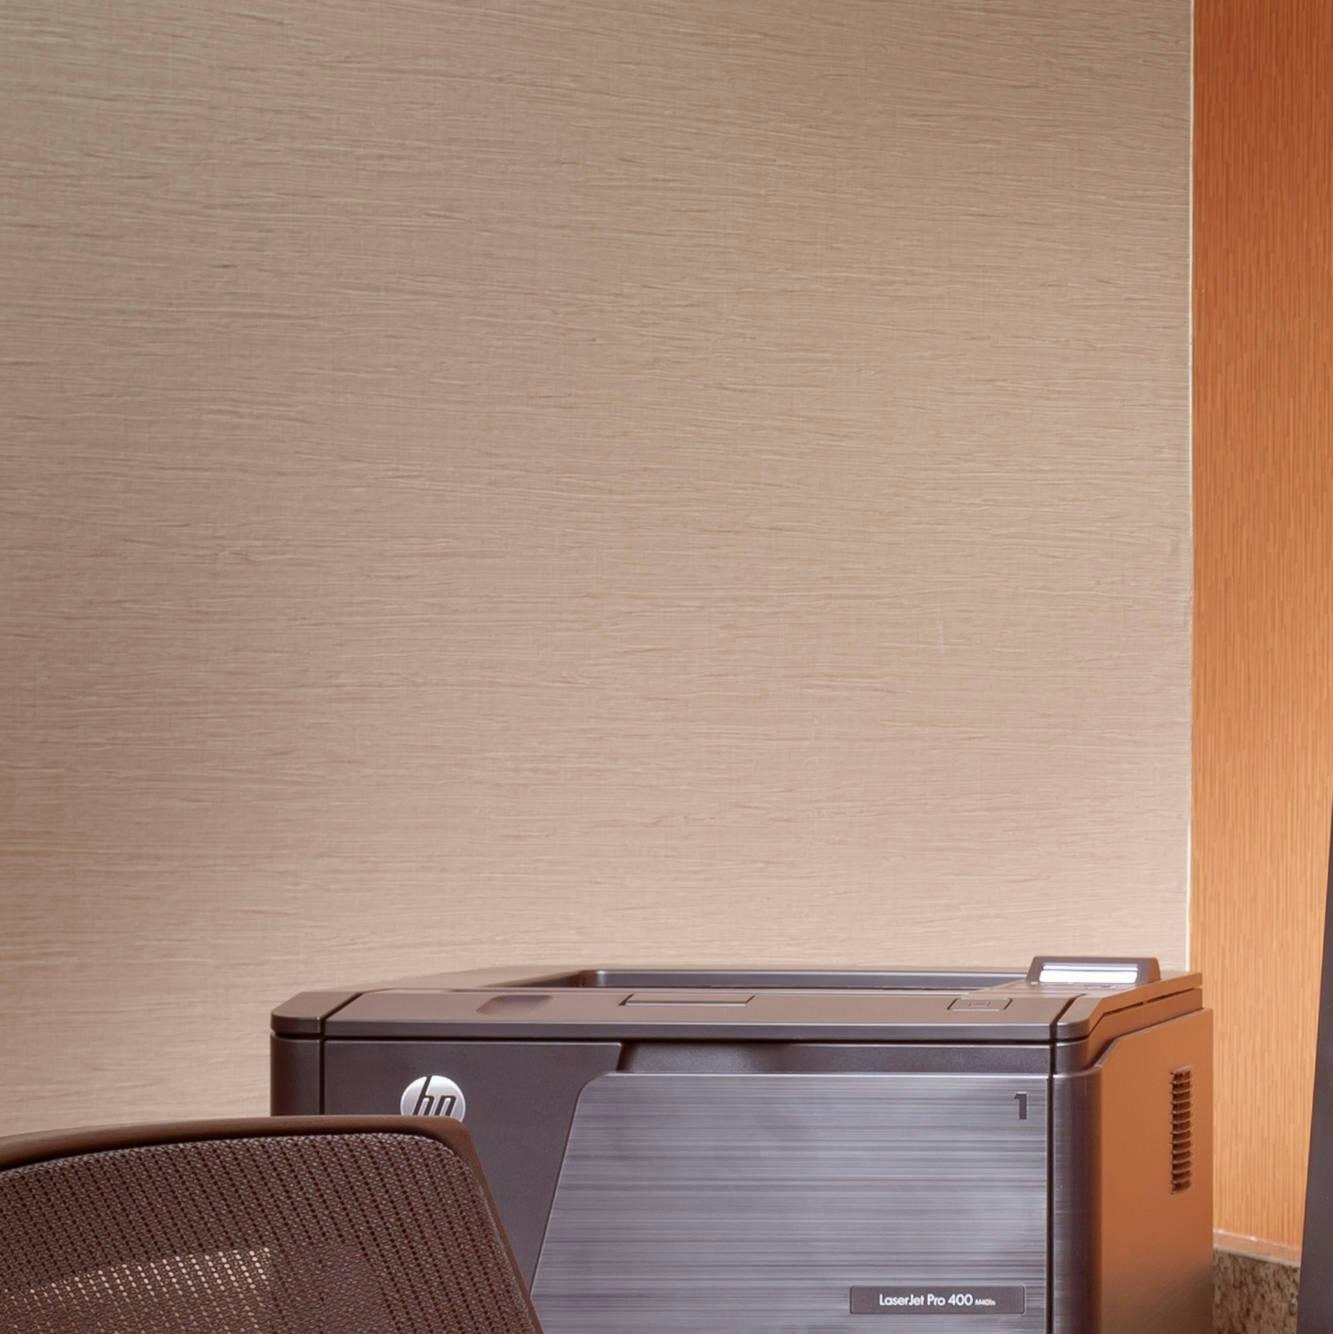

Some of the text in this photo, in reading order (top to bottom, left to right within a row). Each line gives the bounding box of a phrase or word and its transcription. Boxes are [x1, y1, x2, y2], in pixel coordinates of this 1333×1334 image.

[1014, 1092, 1027, 1120] 1
[879, 1293, 924, 1306] LaserJet
[927, 1293, 945, 1306] Pro
[948, 1293, 974, 1306] 400
